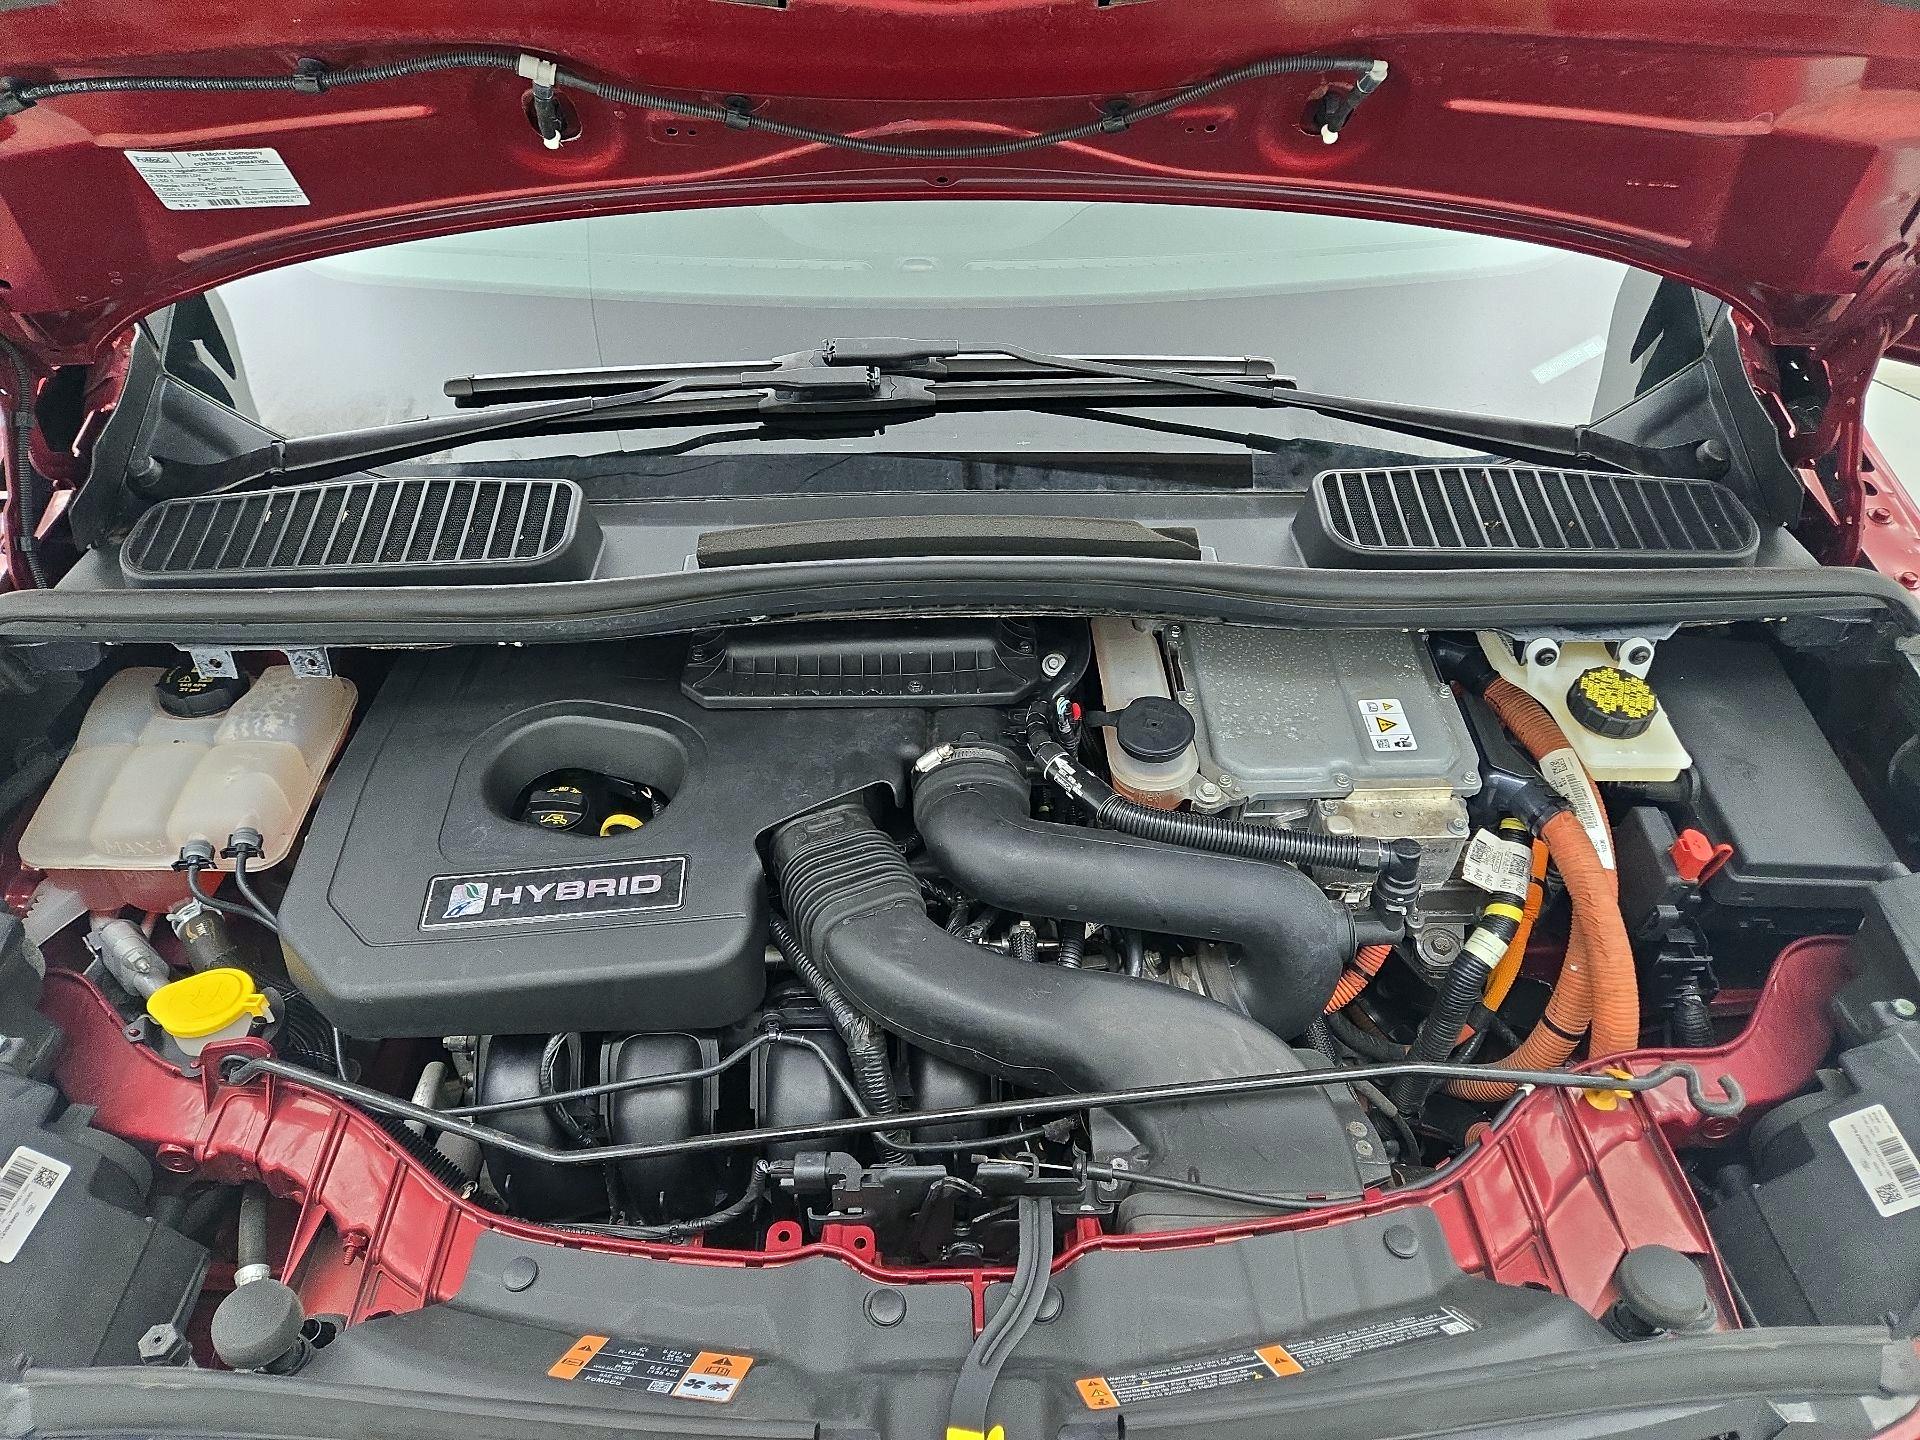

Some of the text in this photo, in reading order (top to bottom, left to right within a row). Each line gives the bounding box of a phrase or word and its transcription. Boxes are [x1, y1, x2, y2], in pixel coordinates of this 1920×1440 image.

[491, 874, 662, 906] HYBRID
[583, 1375, 623, 1385] FoMoCo
[1106, 1373, 1136, 1381] Warning:
